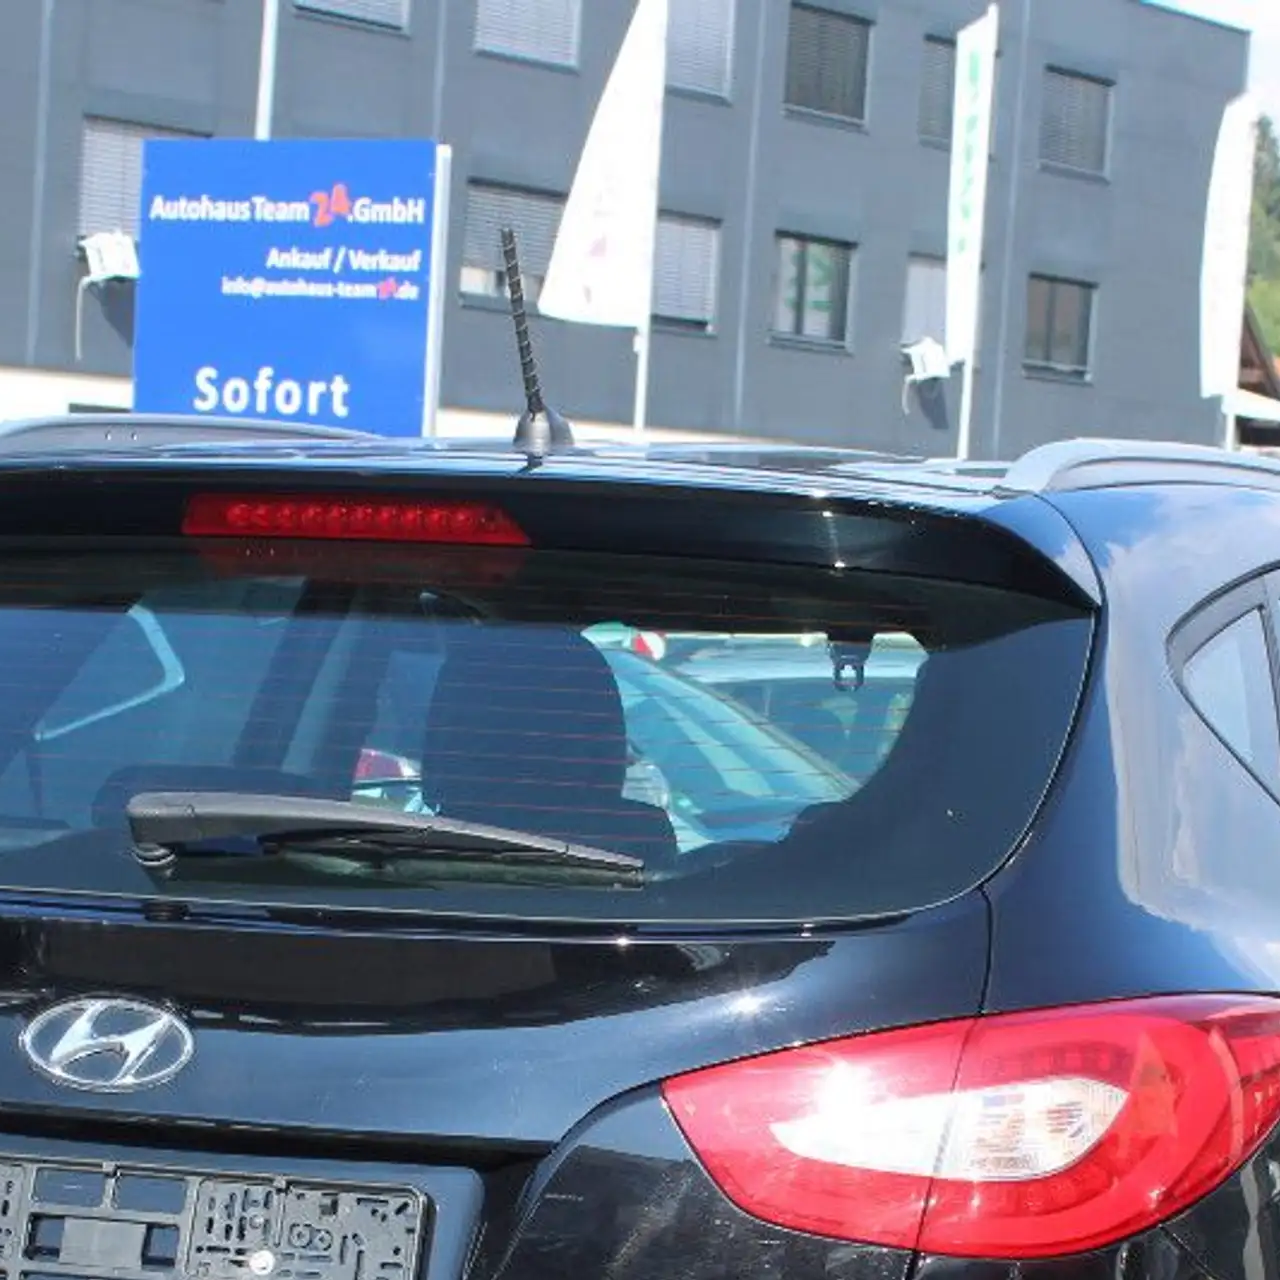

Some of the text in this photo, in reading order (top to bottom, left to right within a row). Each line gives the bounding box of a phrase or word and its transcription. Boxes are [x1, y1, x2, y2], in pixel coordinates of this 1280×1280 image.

[149, 195, 250, 221] Autohaus
[266, 248, 331, 270] Ankauf
[349, 249, 422, 272] Verkauf
[193, 366, 350, 416] Sofort
